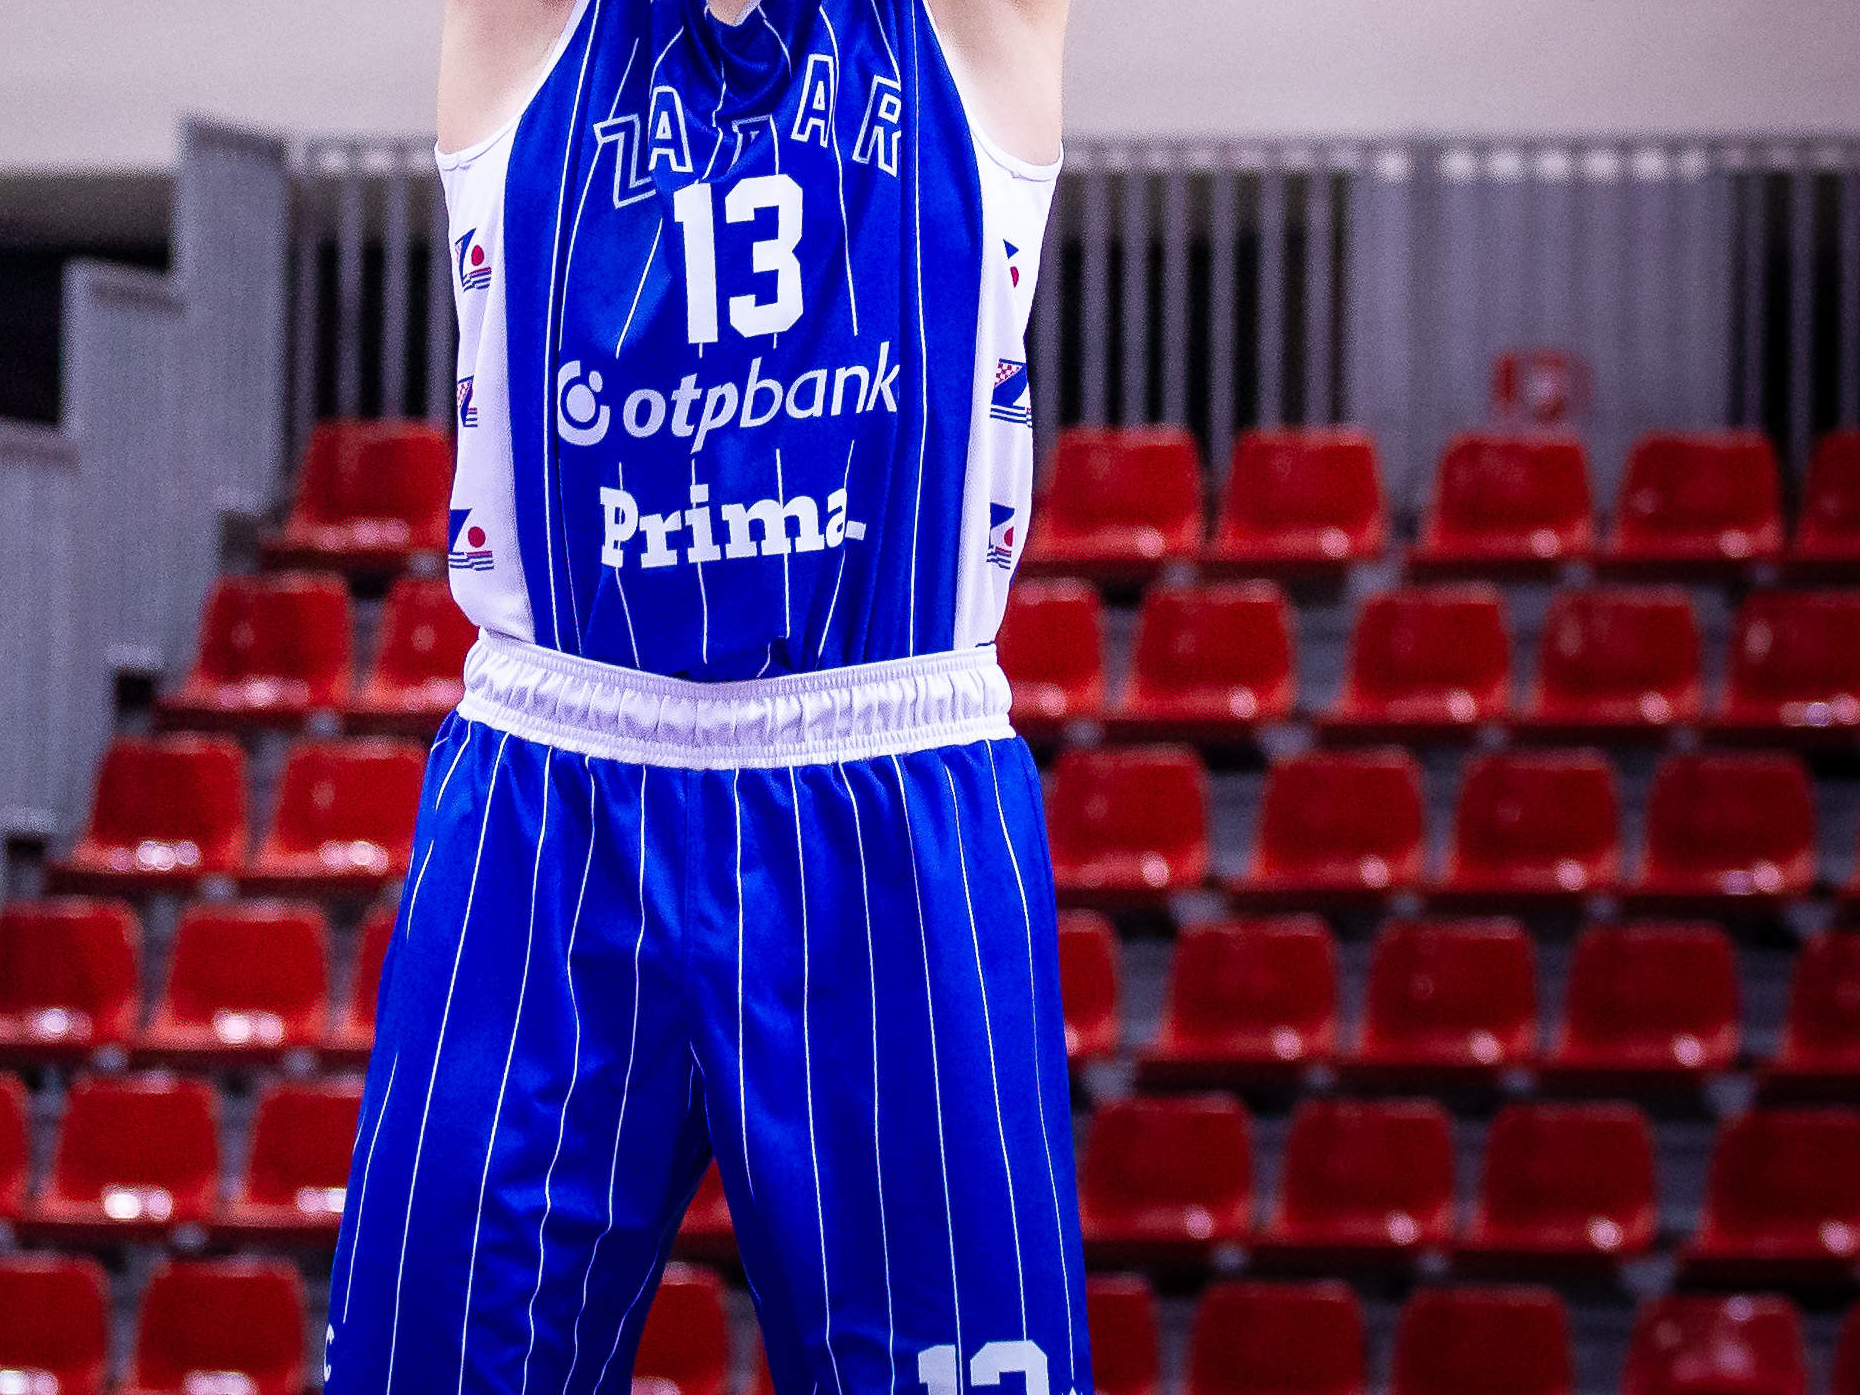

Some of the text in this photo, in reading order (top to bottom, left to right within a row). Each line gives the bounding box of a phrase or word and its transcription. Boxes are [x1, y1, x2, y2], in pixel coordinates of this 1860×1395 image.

[673, 173, 804, 344] 13
[622, 341, 901, 454] otpbank
[600, 482, 867, 569] Prima
